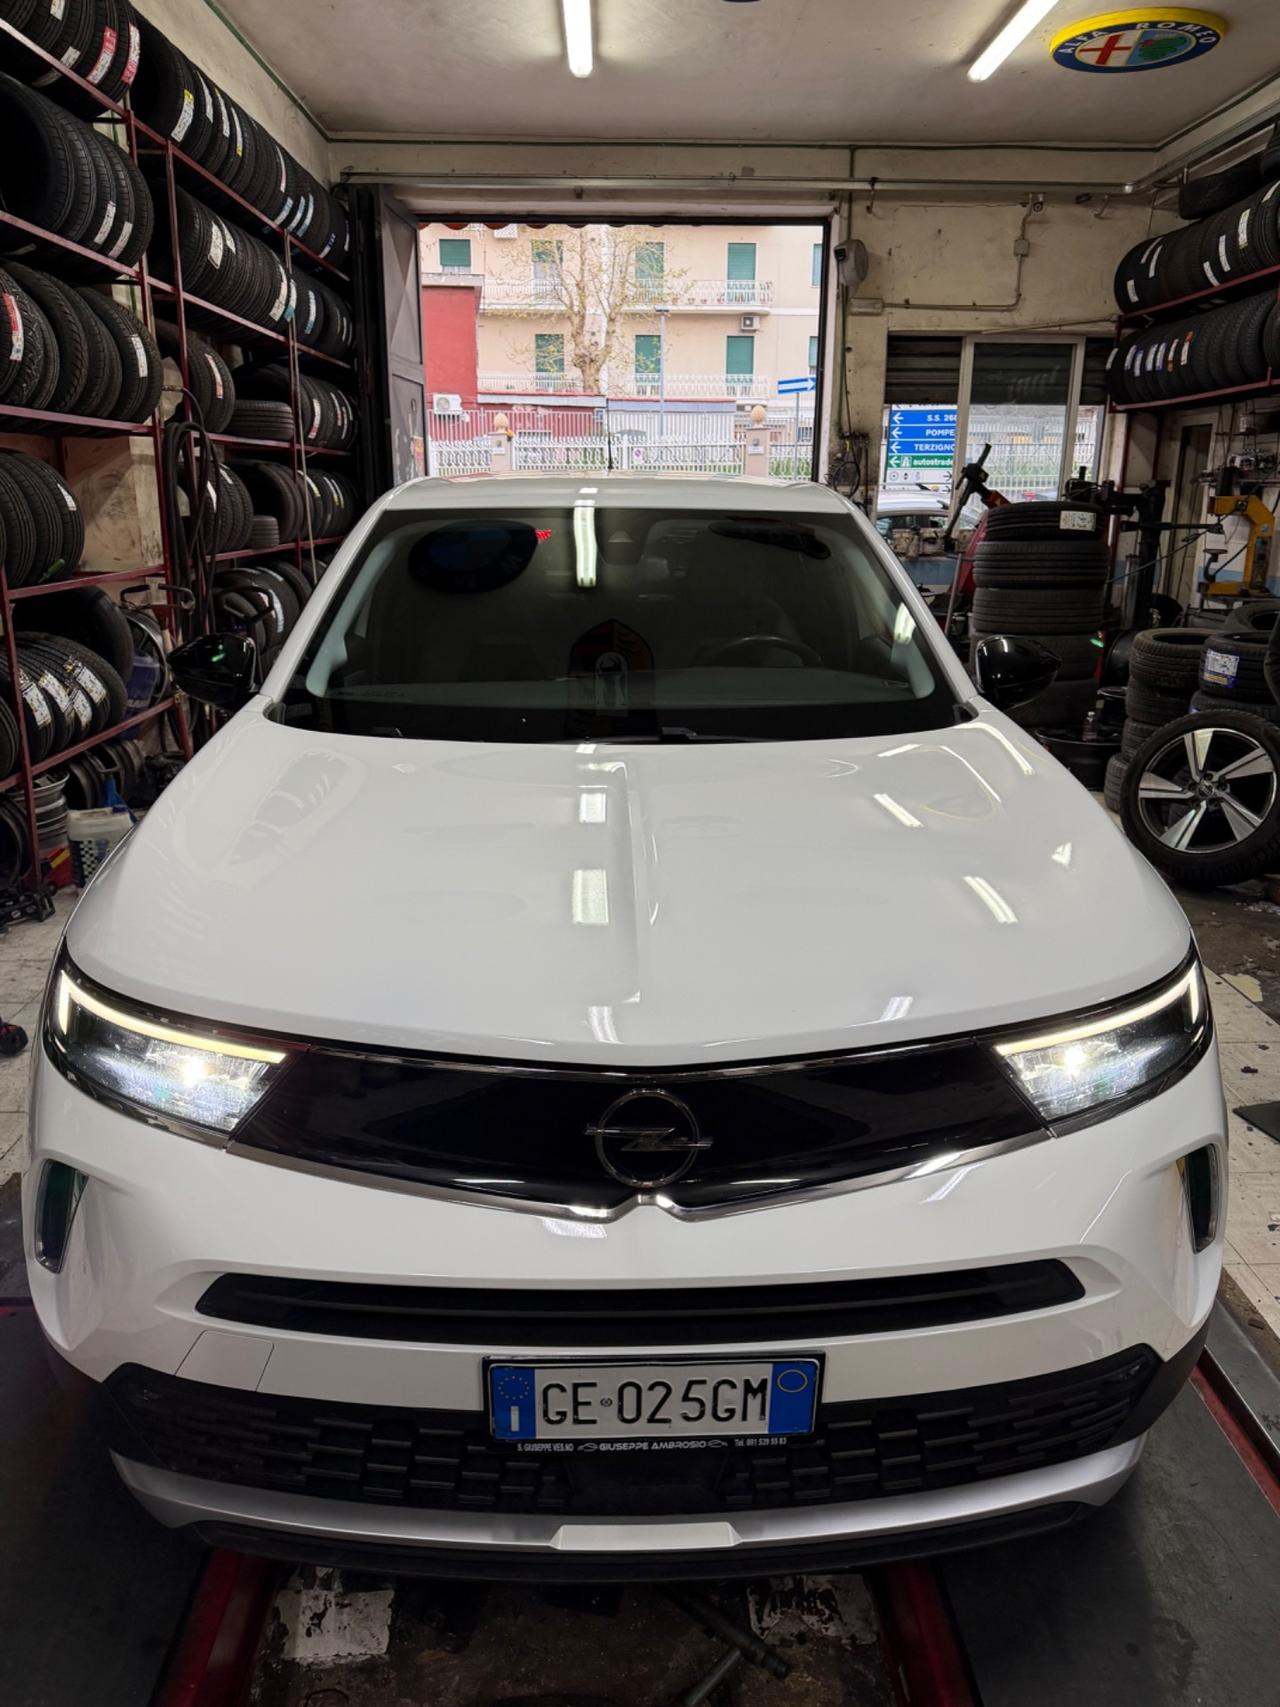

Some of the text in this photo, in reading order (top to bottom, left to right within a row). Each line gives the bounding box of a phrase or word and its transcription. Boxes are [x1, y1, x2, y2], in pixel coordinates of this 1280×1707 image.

[1059, 22, 1217, 54] ALFA ROMEO
[926, 429, 955, 437] POMPE
[541, 1377, 769, 1425] GE 025GM
[599, 1441, 706, 1451] GIUSEPPE AMBROSIO
